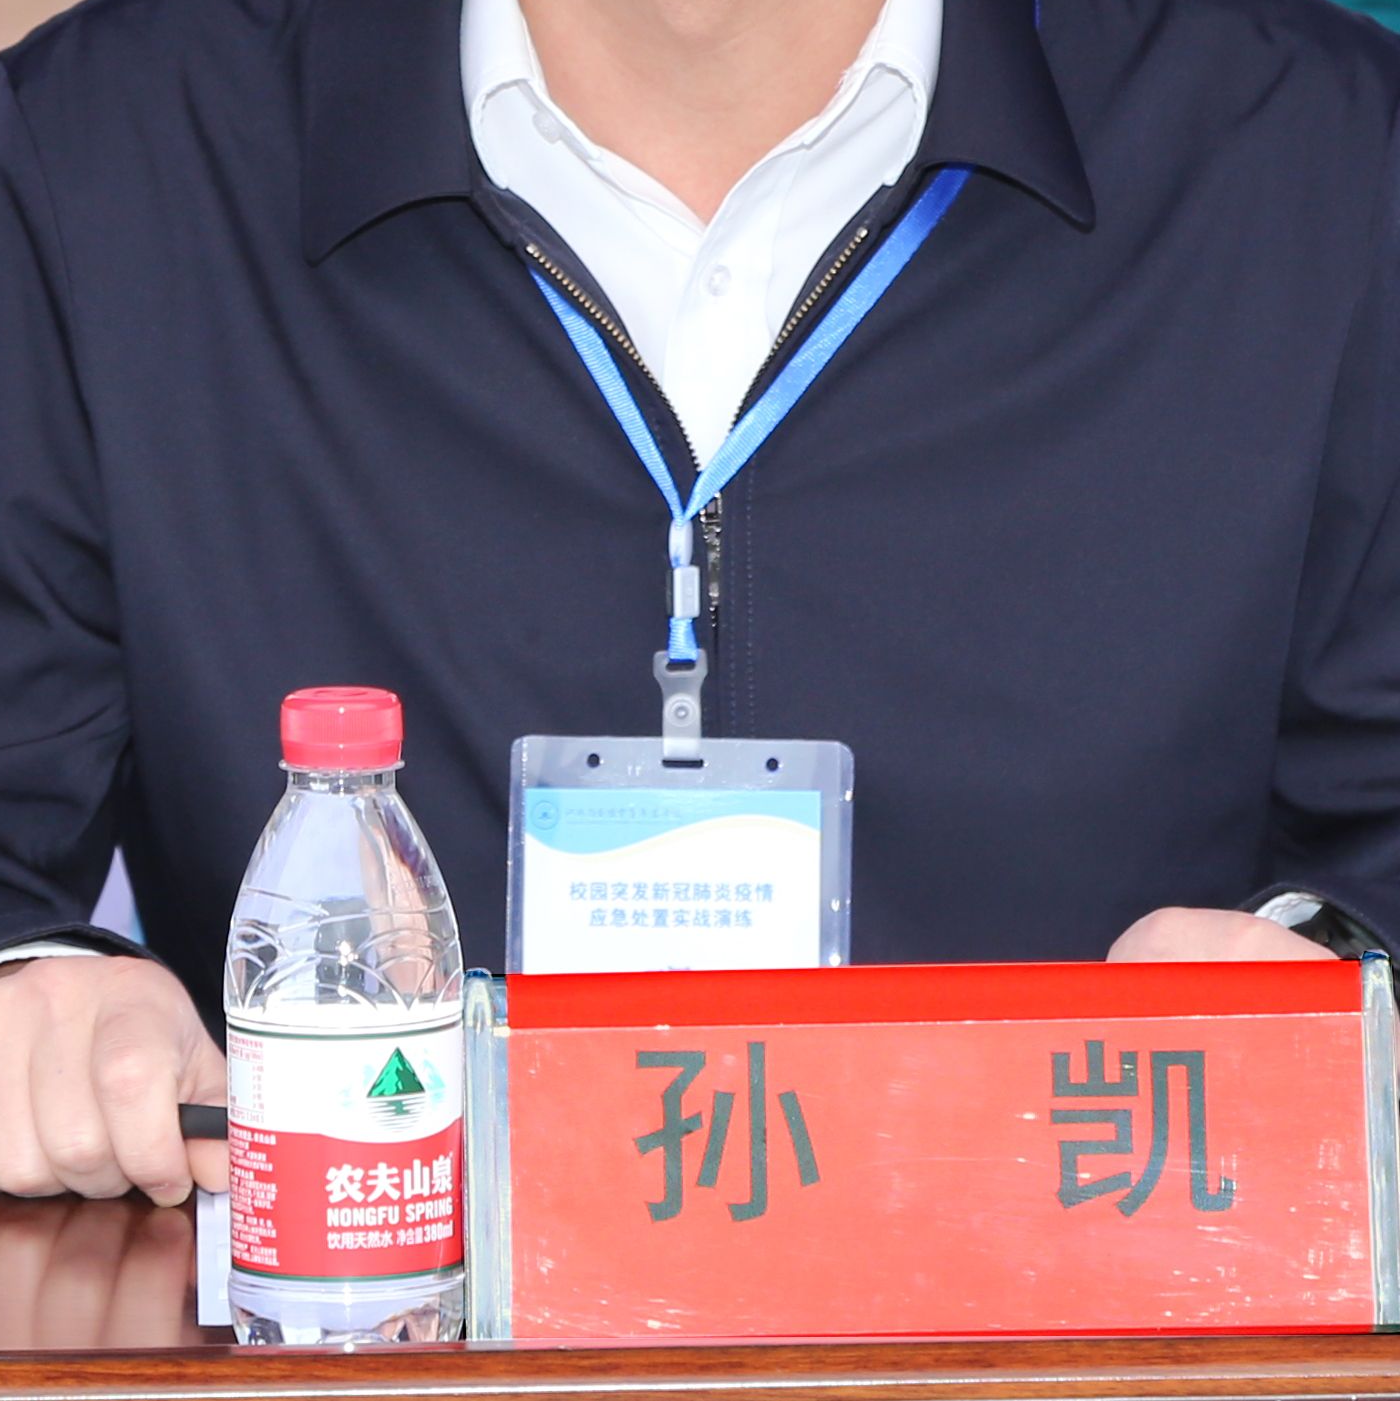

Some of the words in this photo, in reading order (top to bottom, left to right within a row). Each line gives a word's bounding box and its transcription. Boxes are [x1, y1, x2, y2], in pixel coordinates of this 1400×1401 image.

[569, 881, 774, 902] 校园突发新冠肺炎疫情
[589, 908, 753, 928] 应急处置实战演练
[633, 1040, 821, 1223] 孙
[1048, 1039, 1238, 1218] 凯
[325, 1153, 453, 1203] 农夫山泉
[326, 1205, 400, 1227] NONGFU
[405, 1196, 453, 1223] SPRING
[327, 1230, 393, 1250] 饮用天然水
